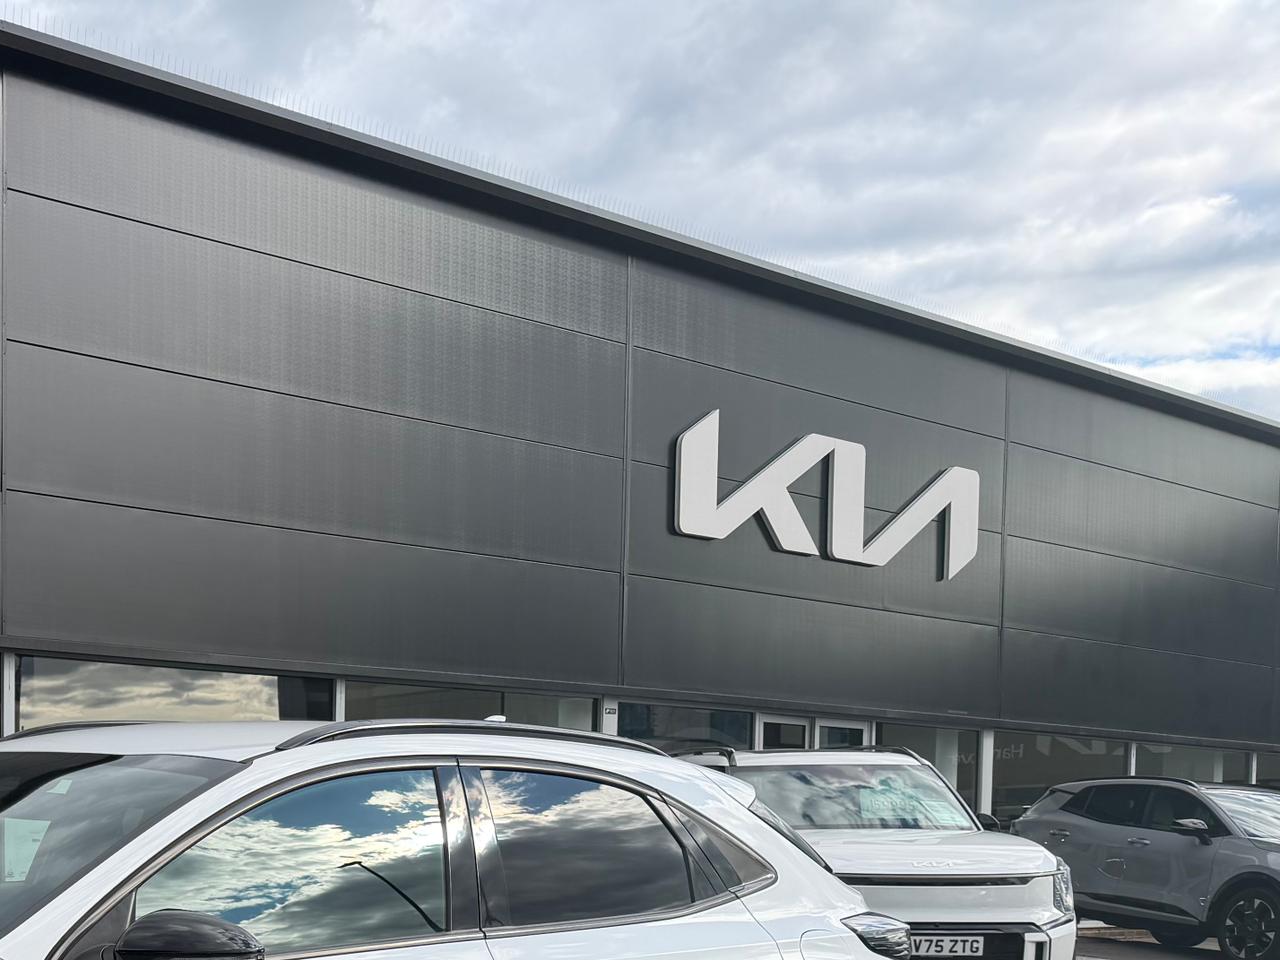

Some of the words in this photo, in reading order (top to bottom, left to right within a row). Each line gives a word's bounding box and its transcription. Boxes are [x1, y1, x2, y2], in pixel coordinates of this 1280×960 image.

[675, 408, 980, 581] KIA
[913, 939, 945, 953] V75
[949, 939, 980, 953] ZTG
